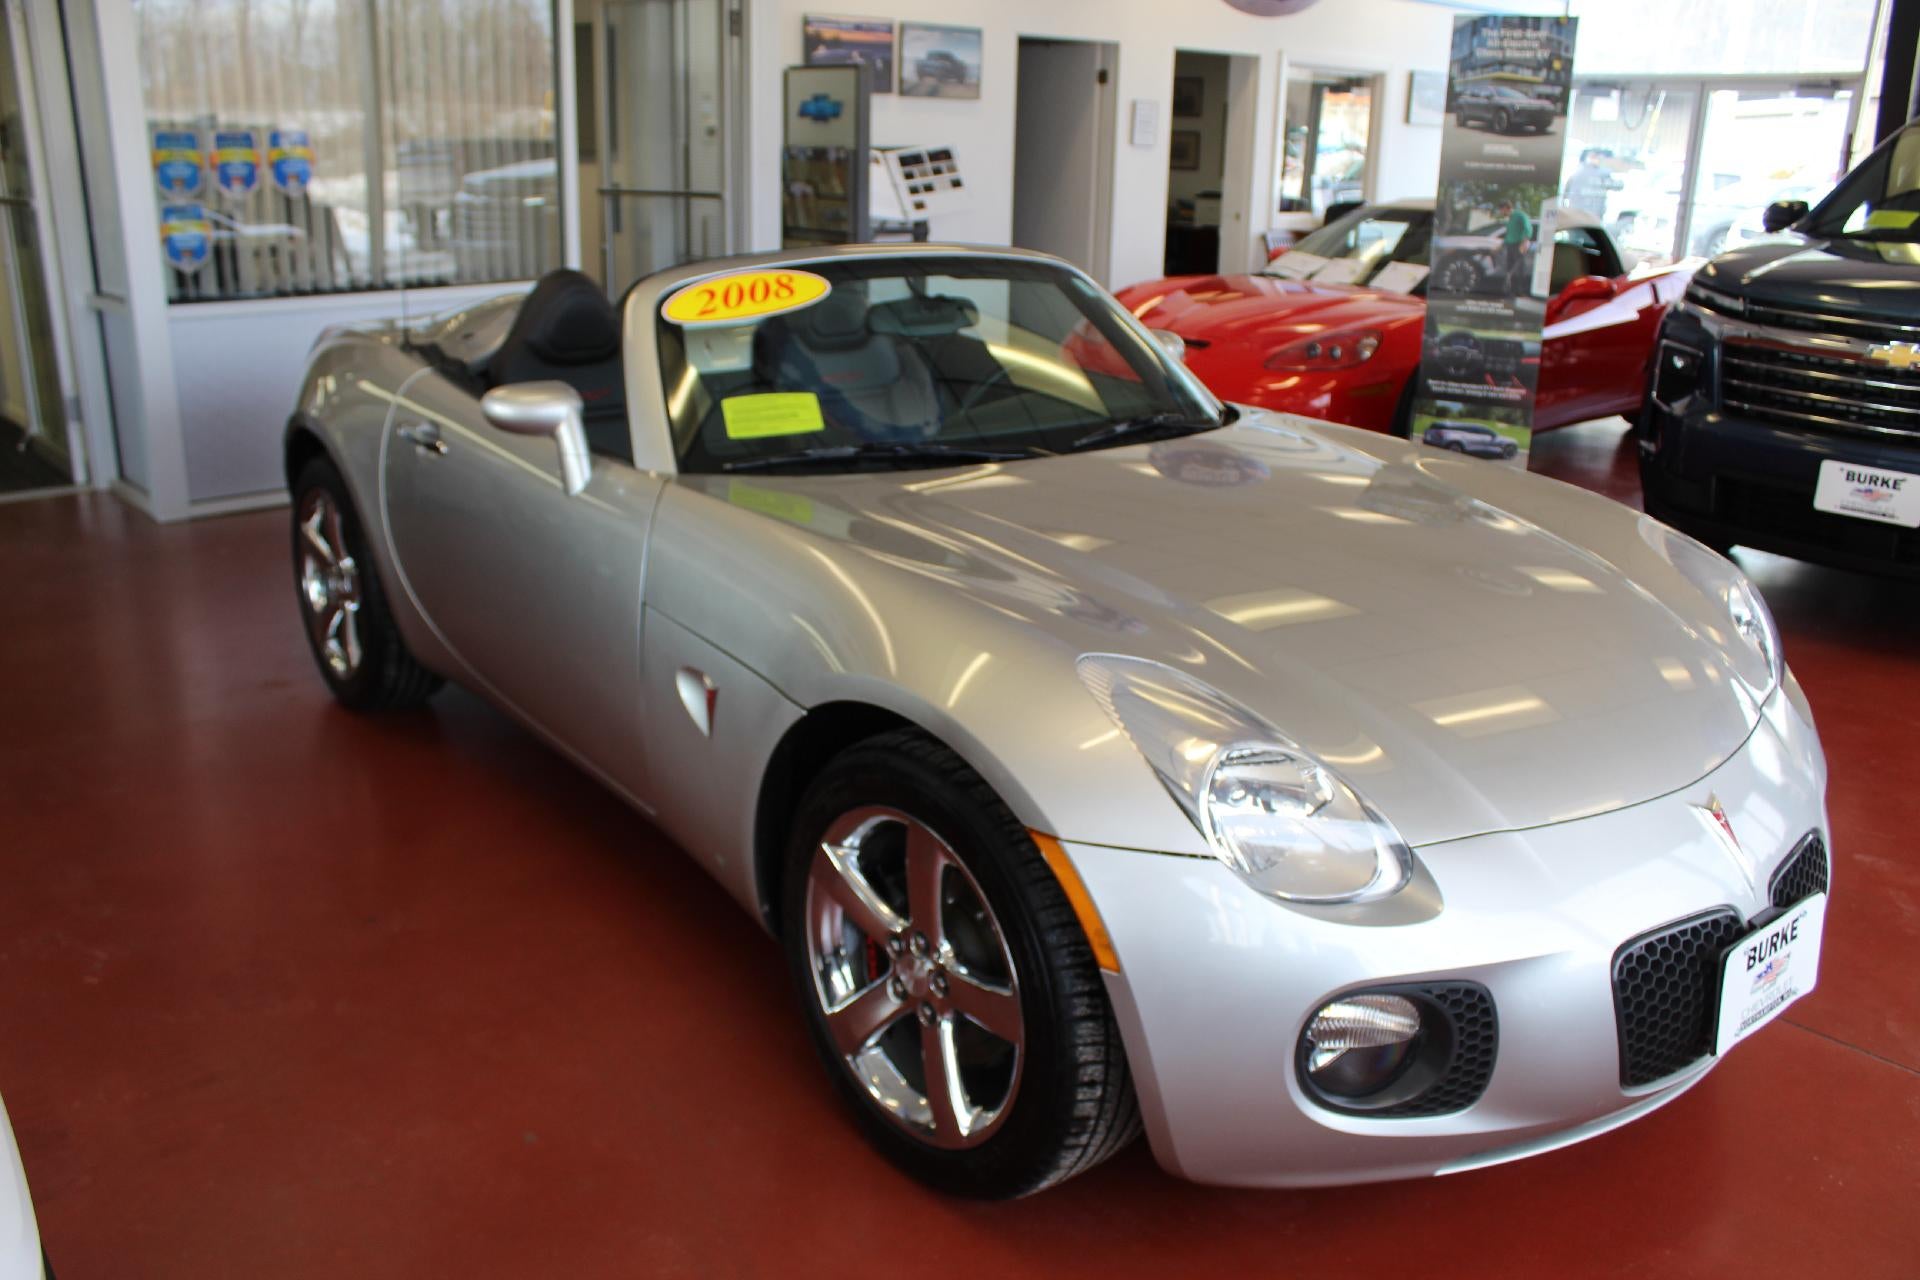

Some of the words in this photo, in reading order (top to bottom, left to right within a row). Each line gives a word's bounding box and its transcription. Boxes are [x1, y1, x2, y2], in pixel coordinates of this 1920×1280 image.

[695, 273, 796, 317] 2008
[1845, 470, 1902, 491] BURKE
[1746, 917, 1799, 972] BURKE
